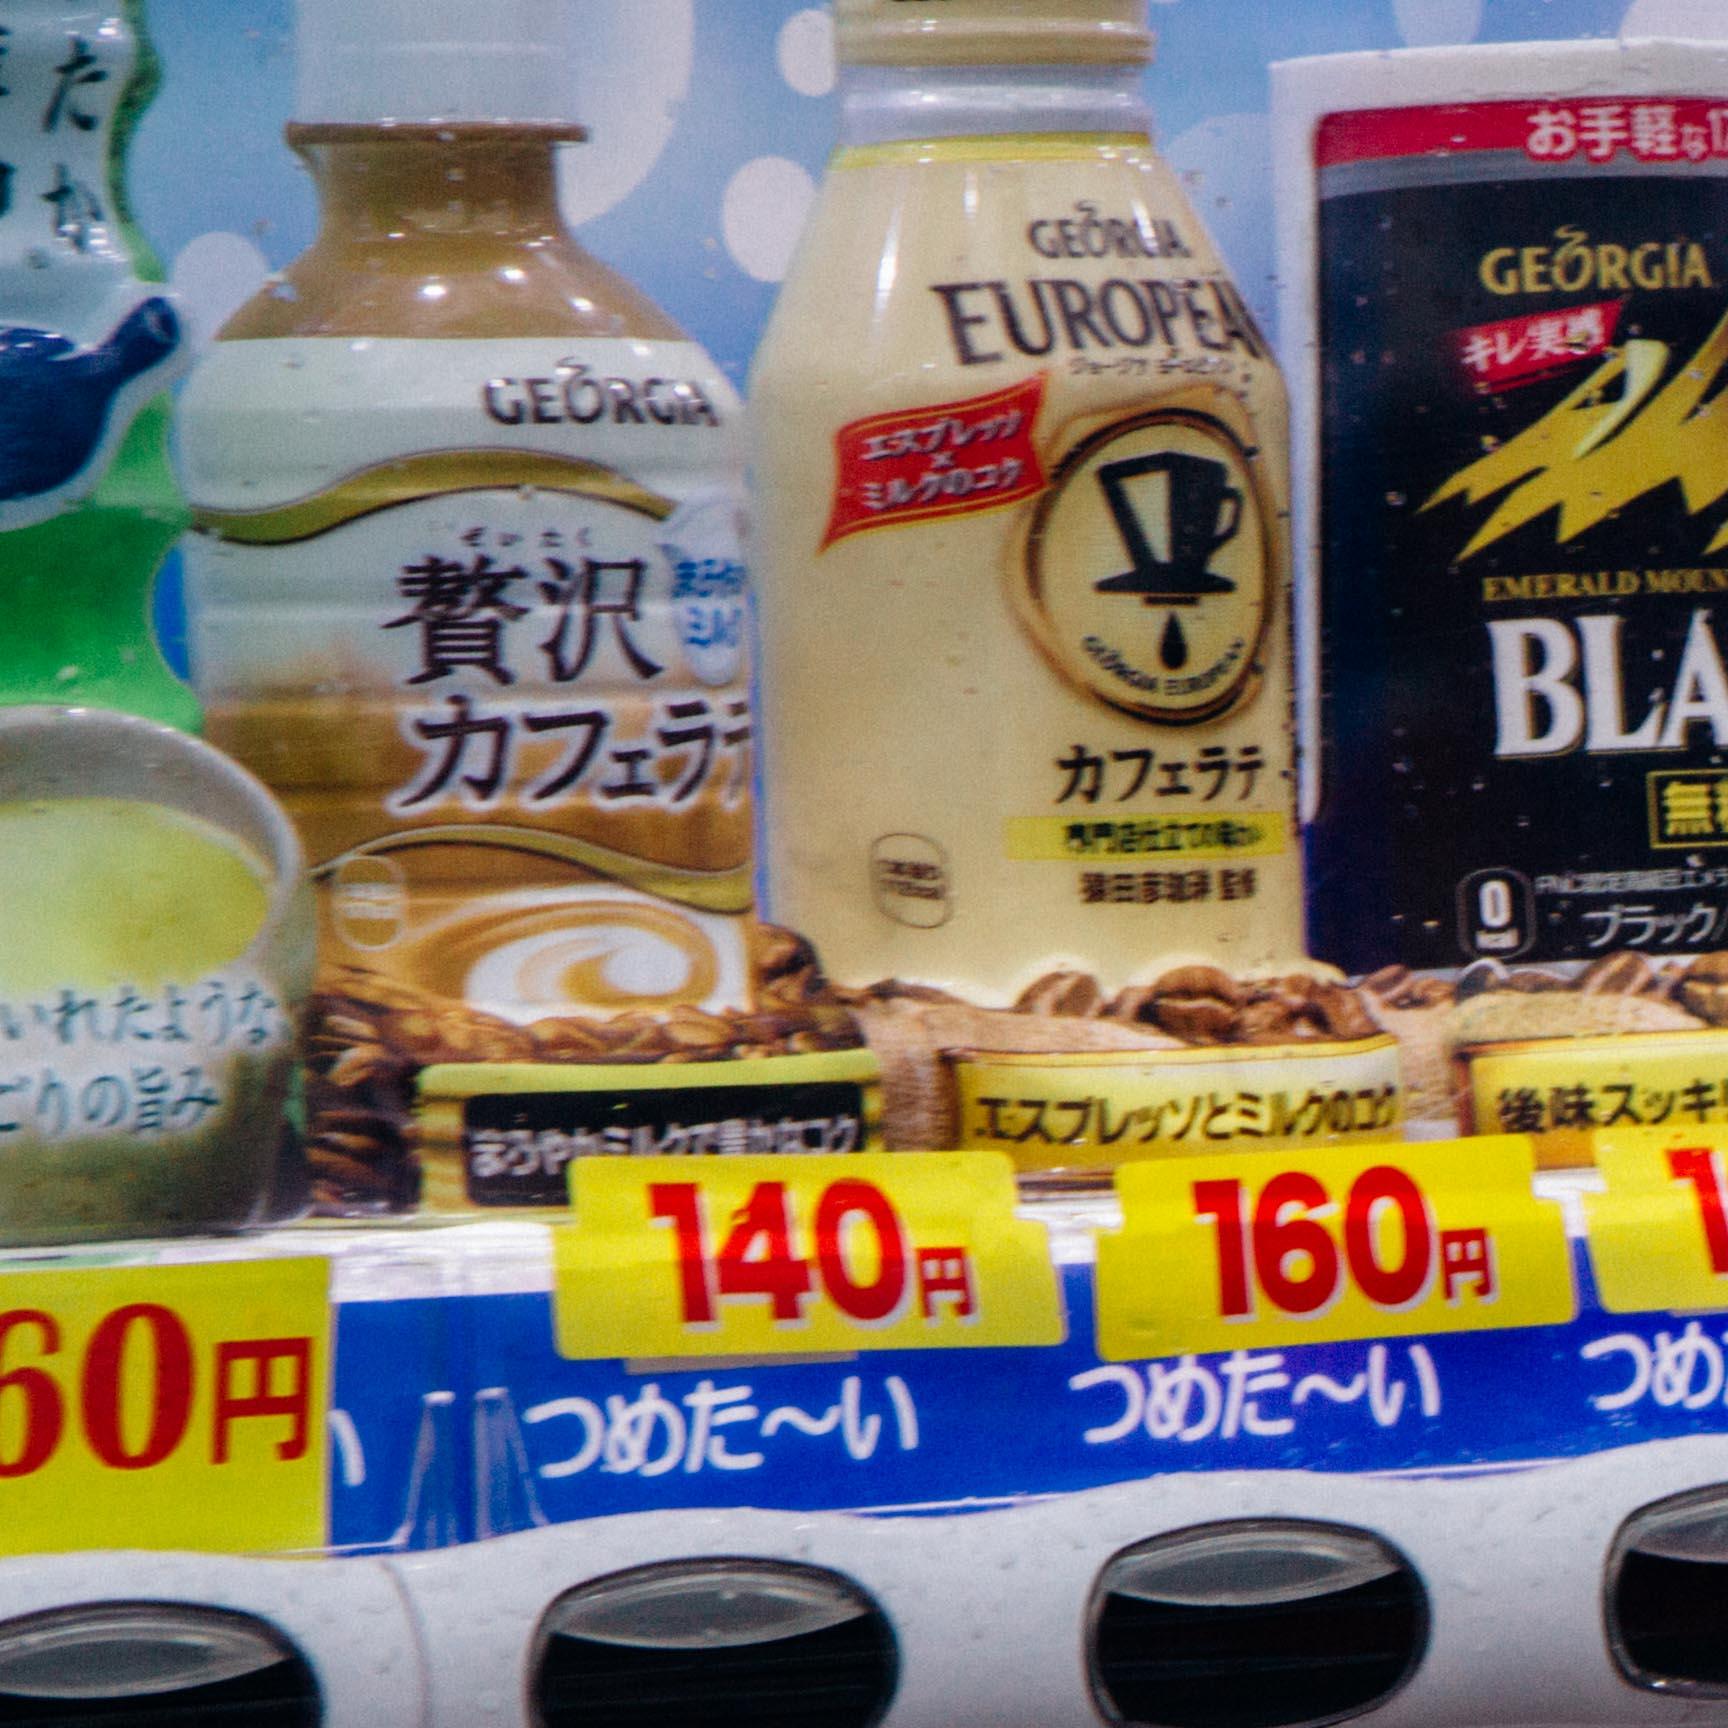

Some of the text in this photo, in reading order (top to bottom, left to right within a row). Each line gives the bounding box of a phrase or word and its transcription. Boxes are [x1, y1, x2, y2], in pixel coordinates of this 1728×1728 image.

[1027, 199, 1191, 262] GEORGIA
[1479, 224, 1712, 296] GEORGIA
[481, 357, 722, 428] GEORGIA
[382, 553, 663, 686] 贅沢
[1482, 573, 1640, 602] EMERALD
[1055, 744, 1267, 804] カフェラテ
[977, 1083, 1399, 1147] エスプレッソとミルクのコク
[648, 1178, 980, 1331] 140円
[1191, 1165, 1498, 1322] 160円
